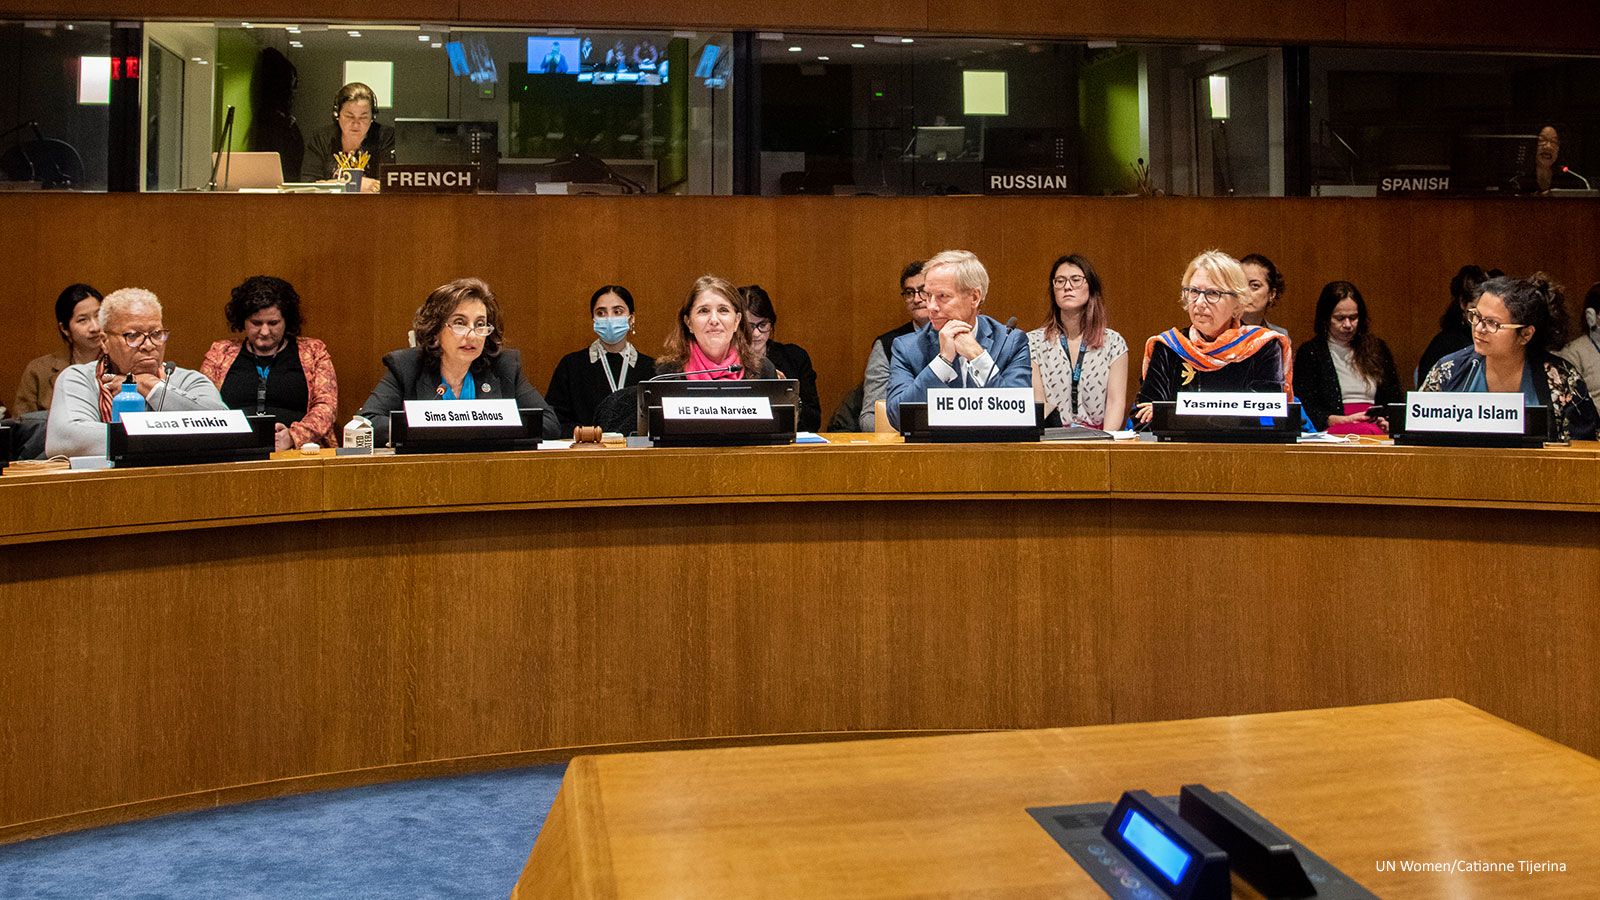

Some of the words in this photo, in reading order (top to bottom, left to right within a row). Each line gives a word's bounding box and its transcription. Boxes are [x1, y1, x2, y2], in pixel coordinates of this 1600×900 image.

[387, 171, 471, 187] FRENCH
[991, 175, 1067, 189] RUSSIAN
[1381, 177, 1449, 191] SPANISH
[678, 406, 692, 415] HE
[693, 406, 719, 415] Paula
[720, 405, 758, 415] Narváez
[936, 396, 955, 411] HE
[957, 396, 984, 411] Olof
[987, 396, 1026, 414] Skoog
[1183, 399, 1239, 409] Yasmine
[1243, 400, 1282, 411] Ergas
[424, 411, 447, 422] Sima
[448, 410, 470, 422] Sami
[471, 410, 504, 421] Bahous
[1411, 403, 1473, 422] Sumaiya
[1478, 404, 1518, 420] Islam
[145, 419, 180, 429] Lana
[181, 416, 228, 428] Finikin
